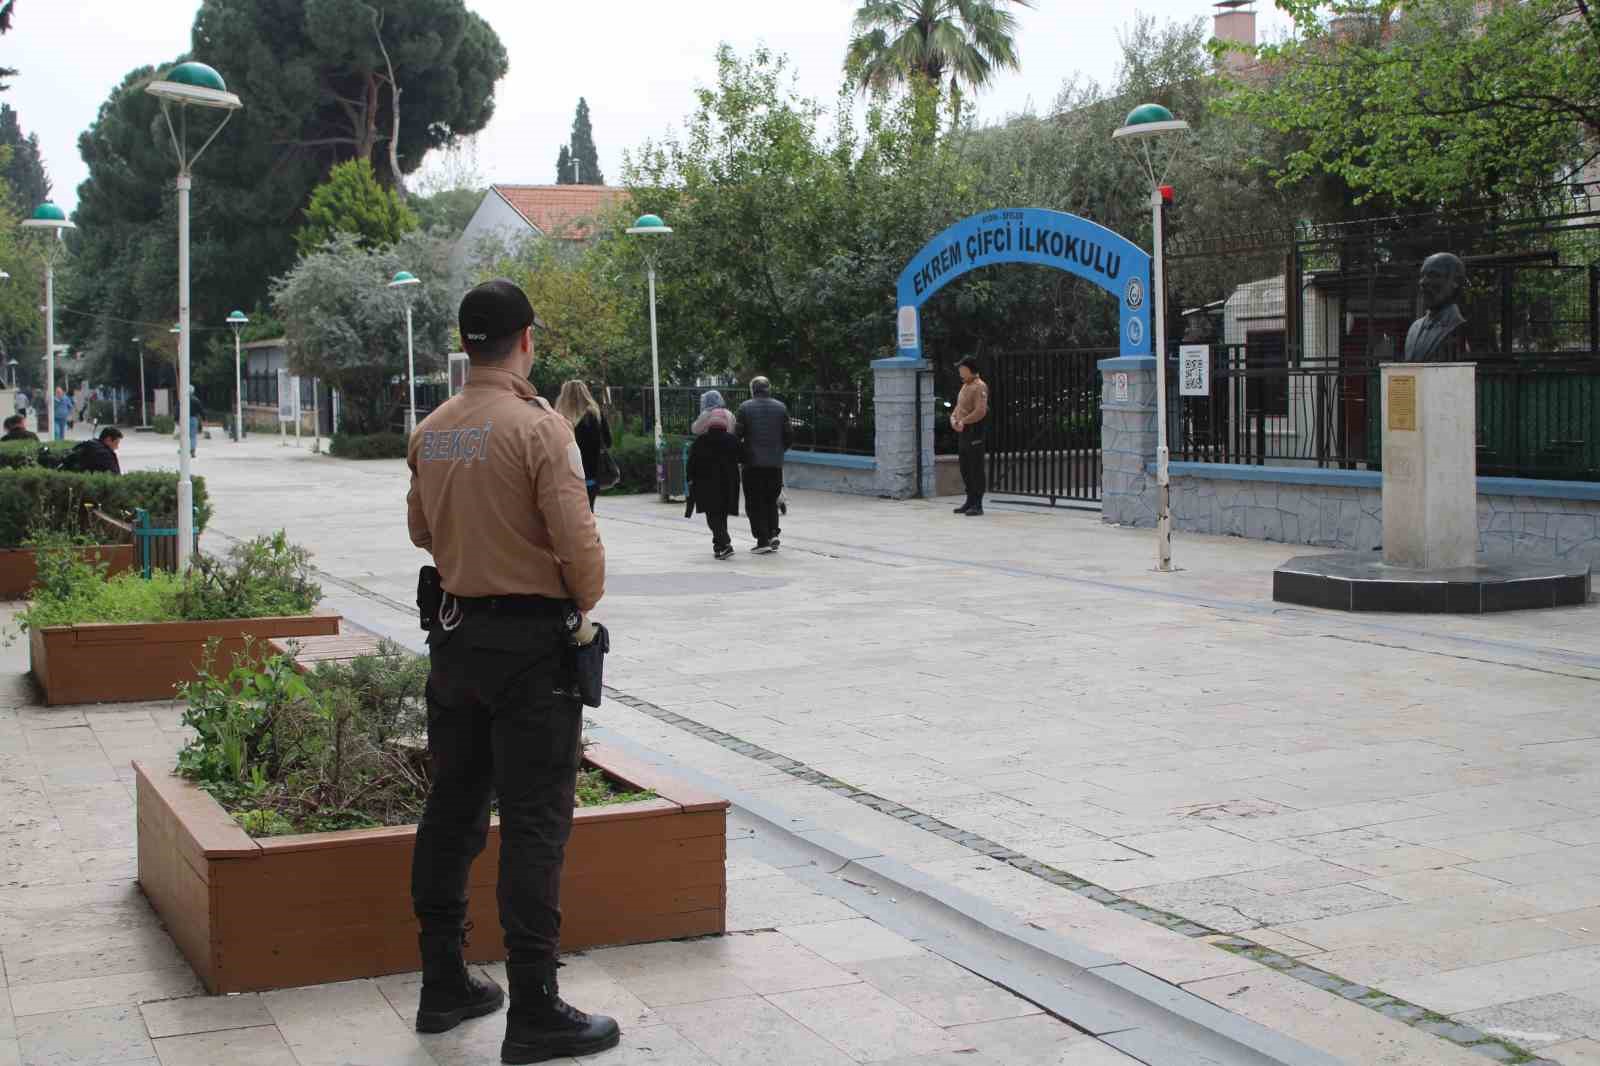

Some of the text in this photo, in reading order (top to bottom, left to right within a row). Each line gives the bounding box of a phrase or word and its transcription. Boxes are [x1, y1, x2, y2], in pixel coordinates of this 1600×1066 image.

[914, 241, 962, 296] EKREM
[1019, 221, 1121, 279] İLKOKULU
[423, 418, 494, 465] BEKÇİ
